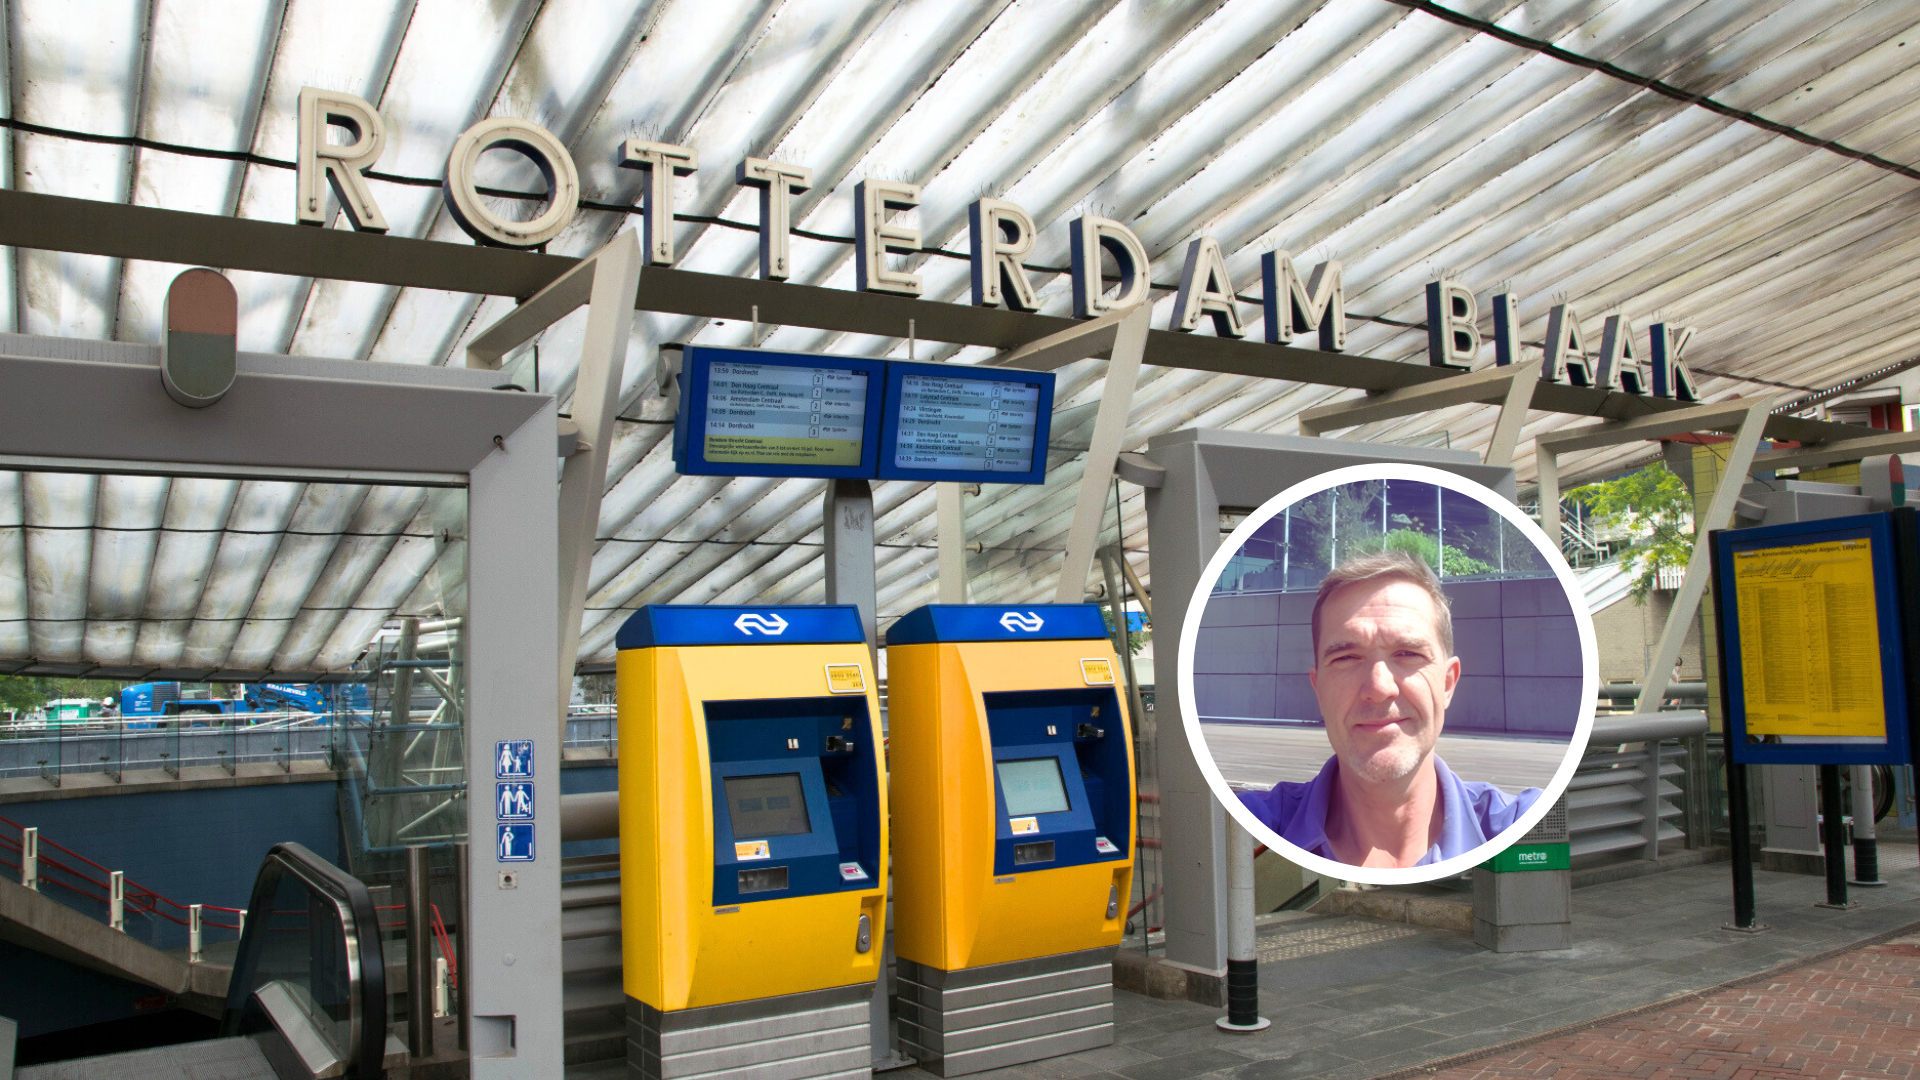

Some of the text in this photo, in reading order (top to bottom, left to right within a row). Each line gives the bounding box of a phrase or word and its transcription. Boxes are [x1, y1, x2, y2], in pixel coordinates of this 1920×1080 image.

[296, 84, 1347, 352] ROTTERDAM
[732, 368, 759, 376] Dordrecht
[730, 395, 759, 403] Amsterdam
[1518, 852, 1547, 860] metro
